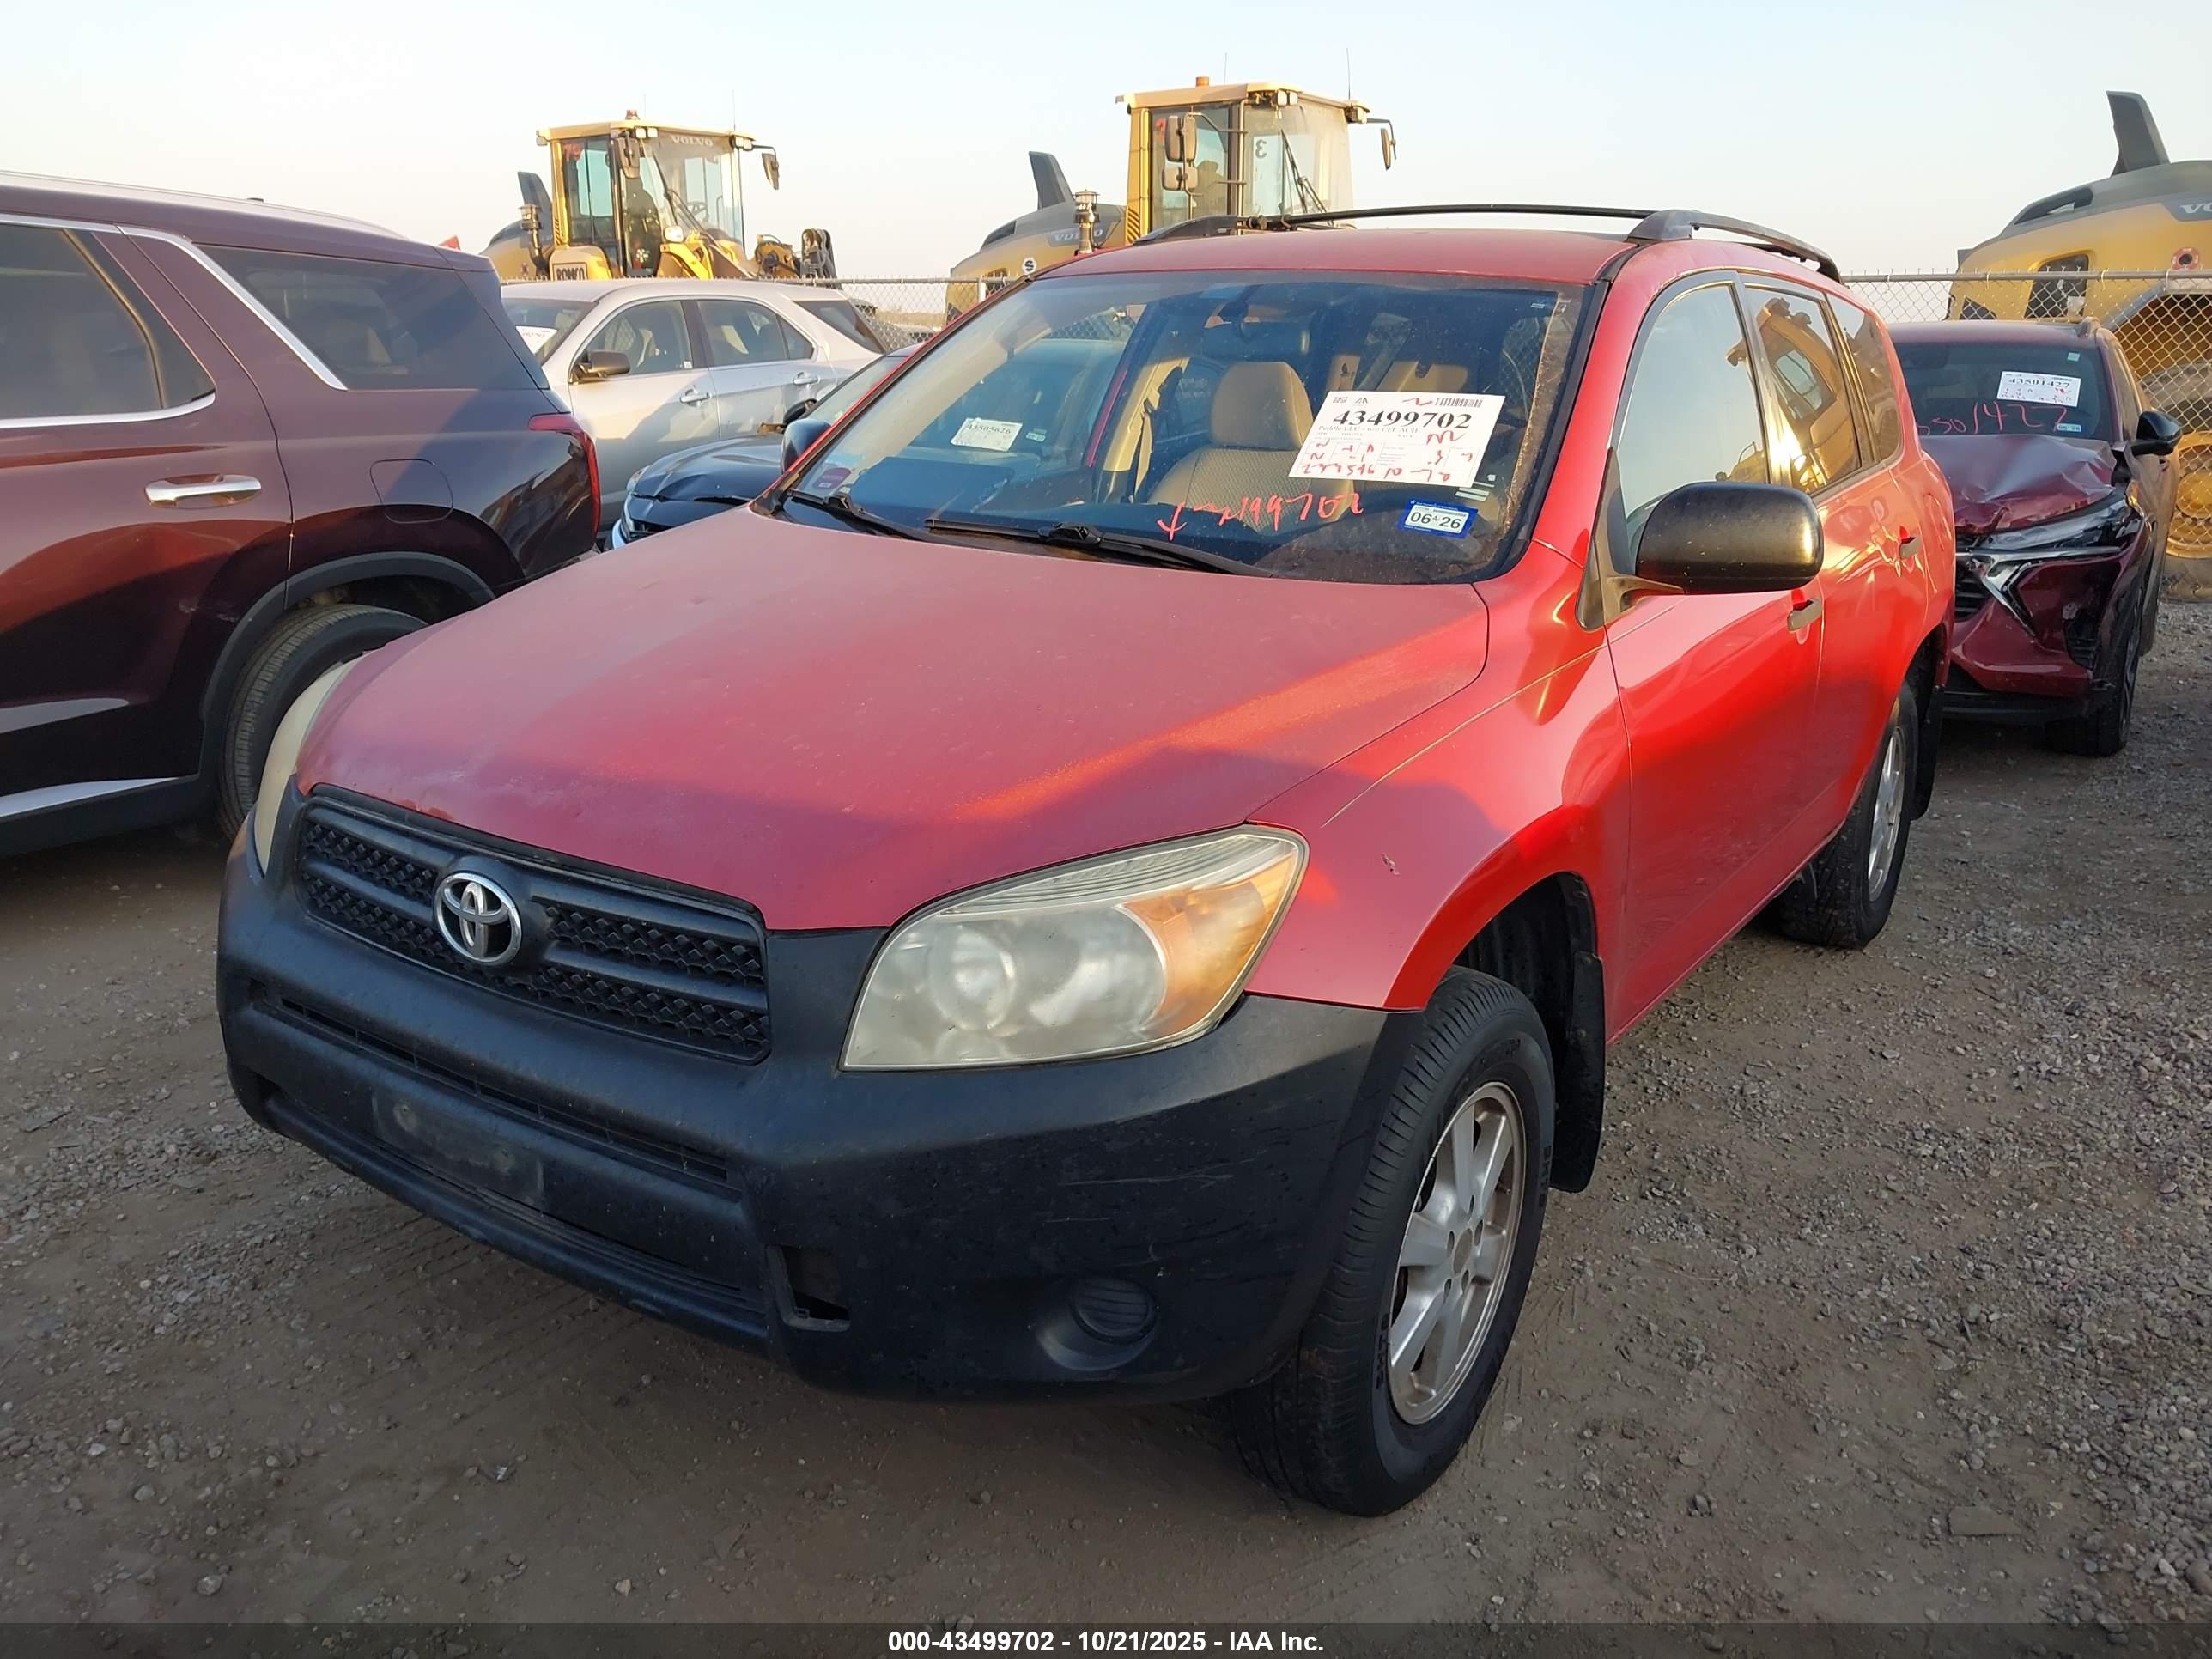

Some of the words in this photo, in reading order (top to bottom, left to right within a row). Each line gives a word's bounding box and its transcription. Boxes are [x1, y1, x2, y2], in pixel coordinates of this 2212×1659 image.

[671, 135, 714, 148] VOLVO
[1333, 410, 1473, 429] 43499702
[1410, 512, 1431, 524] 06
[1439, 516, 1462, 529] 26
